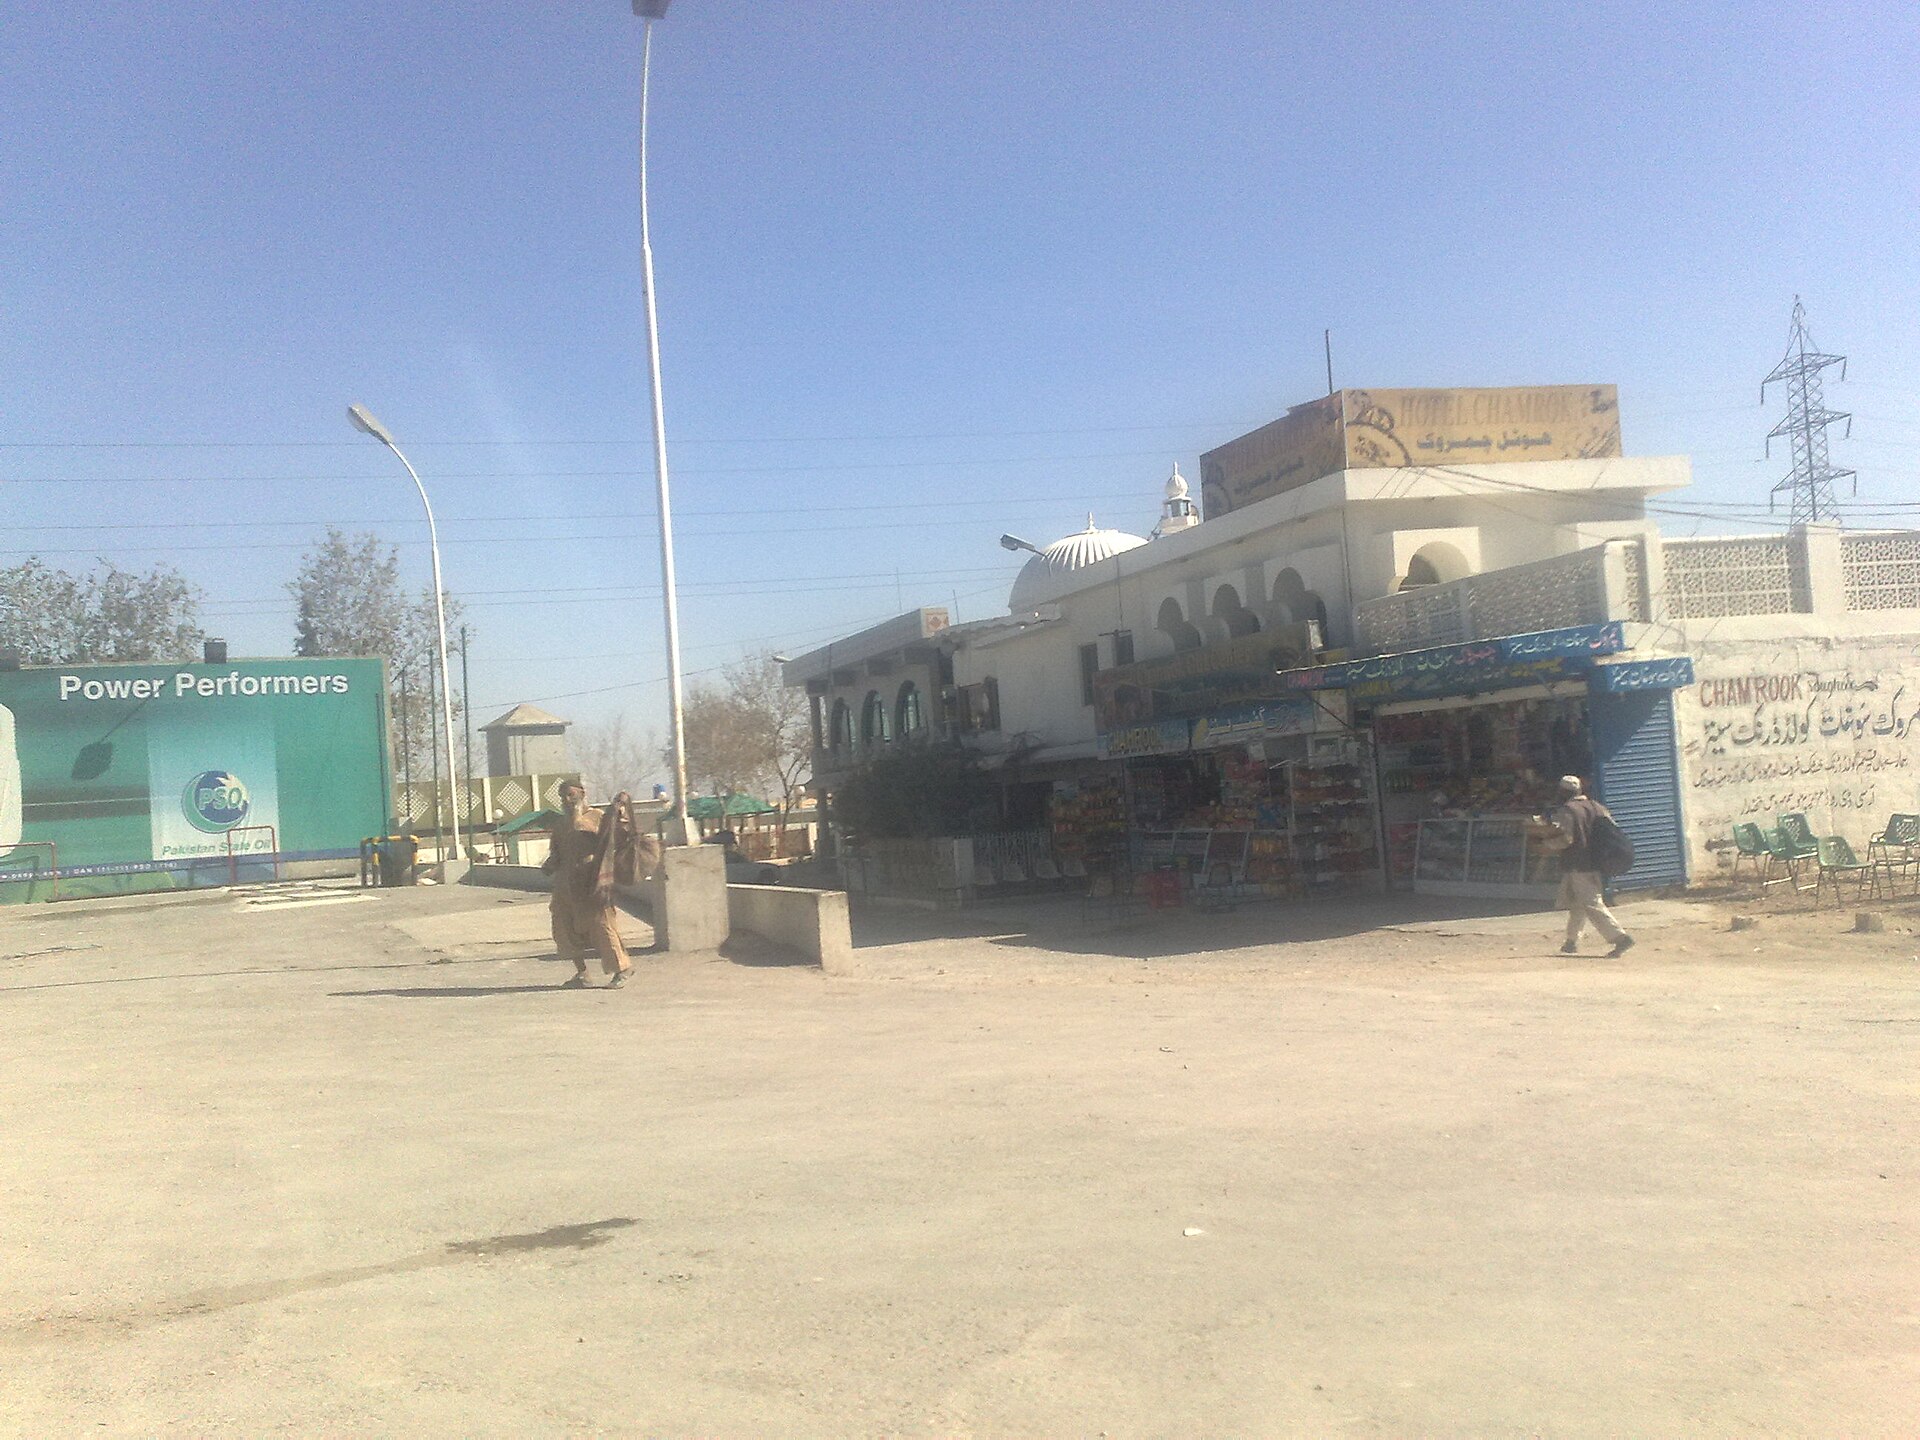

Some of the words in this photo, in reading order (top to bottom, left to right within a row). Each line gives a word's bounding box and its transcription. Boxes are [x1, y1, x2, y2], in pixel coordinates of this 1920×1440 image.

[1400, 393, 1469, 426] HOTEL
[60, 674, 165, 702] Power
[175, 670, 349, 697] Performers
[1700, 674, 1803, 708] CHAMROOK
[199, 786, 243, 812] PSO
[162, 843, 216, 856] Pakistan
[218, 841, 250, 853] Sate
[254, 839, 271, 850] Oil
